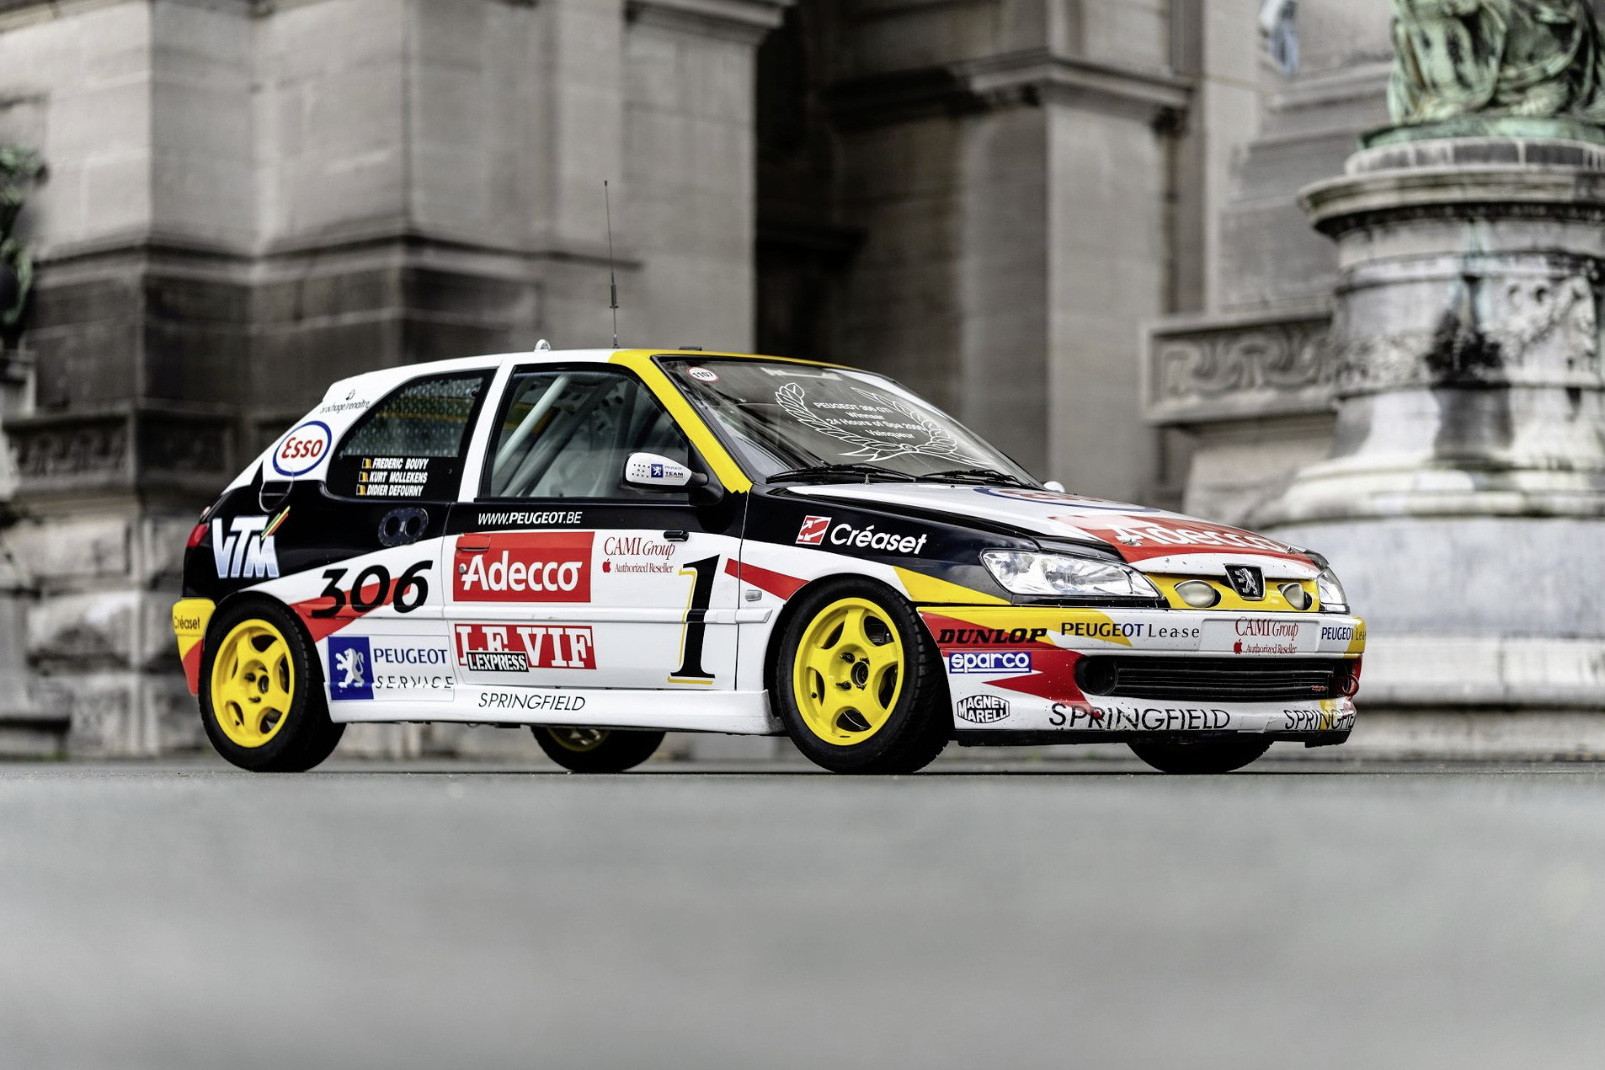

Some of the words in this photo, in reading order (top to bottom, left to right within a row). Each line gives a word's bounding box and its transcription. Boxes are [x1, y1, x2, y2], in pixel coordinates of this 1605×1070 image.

[813, 402, 860, 411] PEUGEOT
[839, 418, 873, 426] Hours
[372, 457, 404, 469] FREDERIC
[405, 458, 429, 469] BOUVY
[369, 471, 388, 483] KURT
[389, 471, 428, 483] MOLLEKENS
[367, 484, 389, 496] DIDIER
[388, 484, 424, 497] DEFOURNY
[478, 511, 583, 525] WWW.PEUGEOT.BE
[211, 515, 280, 579] VTM
[830, 523, 927, 555] Créaset
[1106, 523, 1289, 554] Adecco
[604, 536, 642, 556] CAMI
[642, 540, 676, 560] Group
[461, 550, 583, 592] Adecco
[614, 562, 649, 573] Authorized
[649, 562, 674, 573] Reseller
[311, 560, 434, 619] 306
[173, 614, 200, 630] Créaset
[668, 554, 720, 685] 1
[939, 628, 1048, 644] DUNLOP
[1061, 622, 1144, 637] PEUGEOT
[1148, 623, 1200, 638] Lease
[1235, 616, 1272, 637] CAMI
[1272, 621, 1299, 641] Group
[1321, 626, 1355, 641] PEUGEOT
[456, 625, 509, 665] LE
[516, 627, 593, 668] VIF
[1246, 644, 1278, 653] Authorized
[373, 648, 448, 664] PEUGEOT
[951, 652, 1030, 673] sparco
[375, 675, 454, 689] SERVICE
[478, 692, 586, 711] SPRINGFIELD
[957, 695, 1010, 719] MAGNETI
[957, 702, 1010, 723] MARELLI
[1049, 702, 1231, 730] SPRINGFIELD
